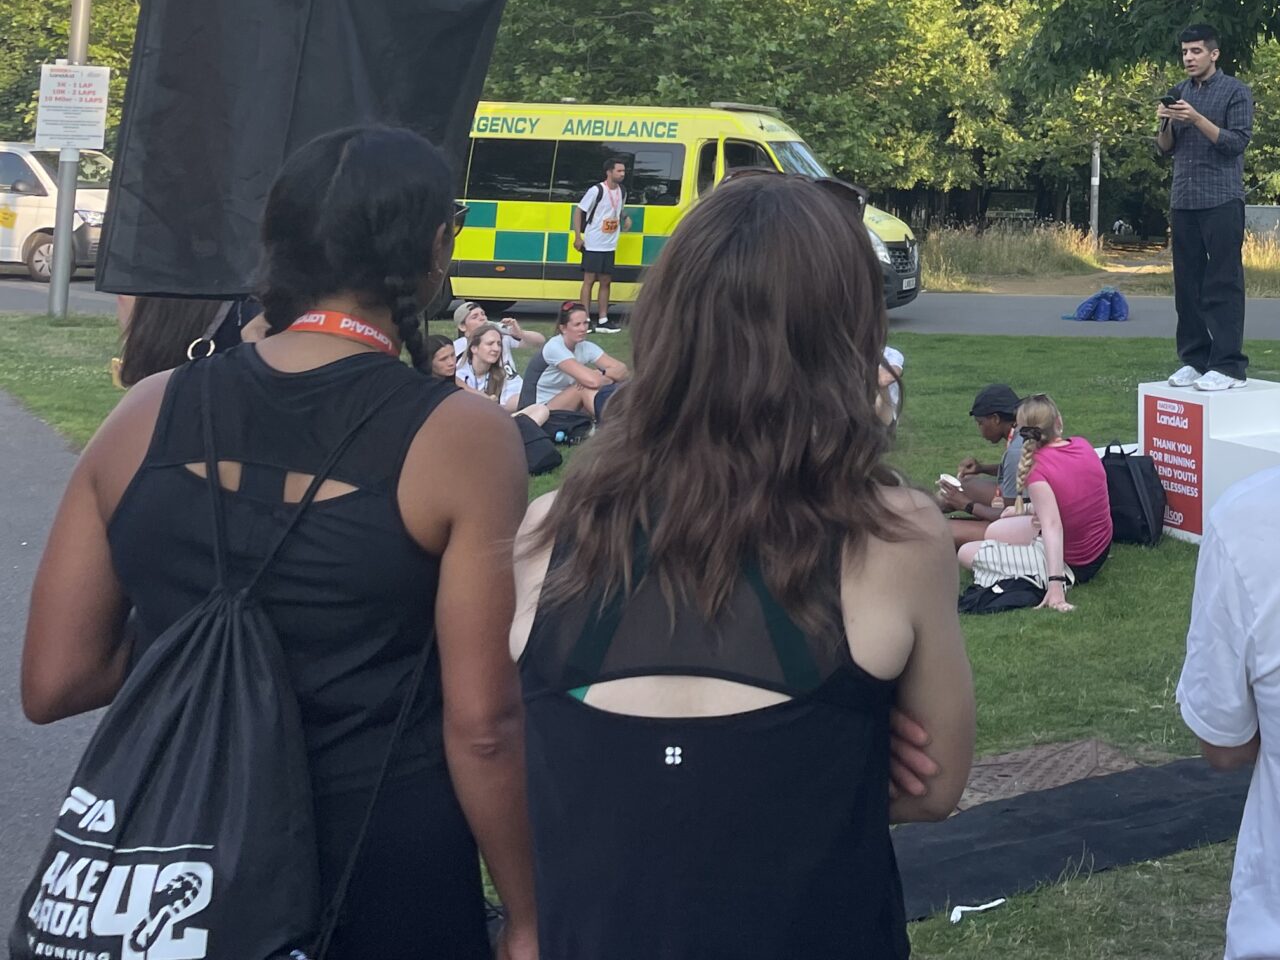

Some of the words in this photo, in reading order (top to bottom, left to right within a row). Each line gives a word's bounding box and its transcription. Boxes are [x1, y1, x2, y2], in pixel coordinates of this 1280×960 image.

[472, 116, 540, 134] GENCY
[562, 119, 679, 138] AMBULANCE
[340, 317, 393, 351] LandAid
[1156, 411, 1188, 429] LandAid
[1153, 437, 1176, 451] THANK
[1176, 442, 1192, 454] YOU
[1149, 449, 1163, 462] FOR
[1163, 453, 1196, 470] RUNNING
[1158, 465, 1172, 478] END
[1172, 468, 1198, 484] YOUTH
[90, 861, 214, 960] 42
